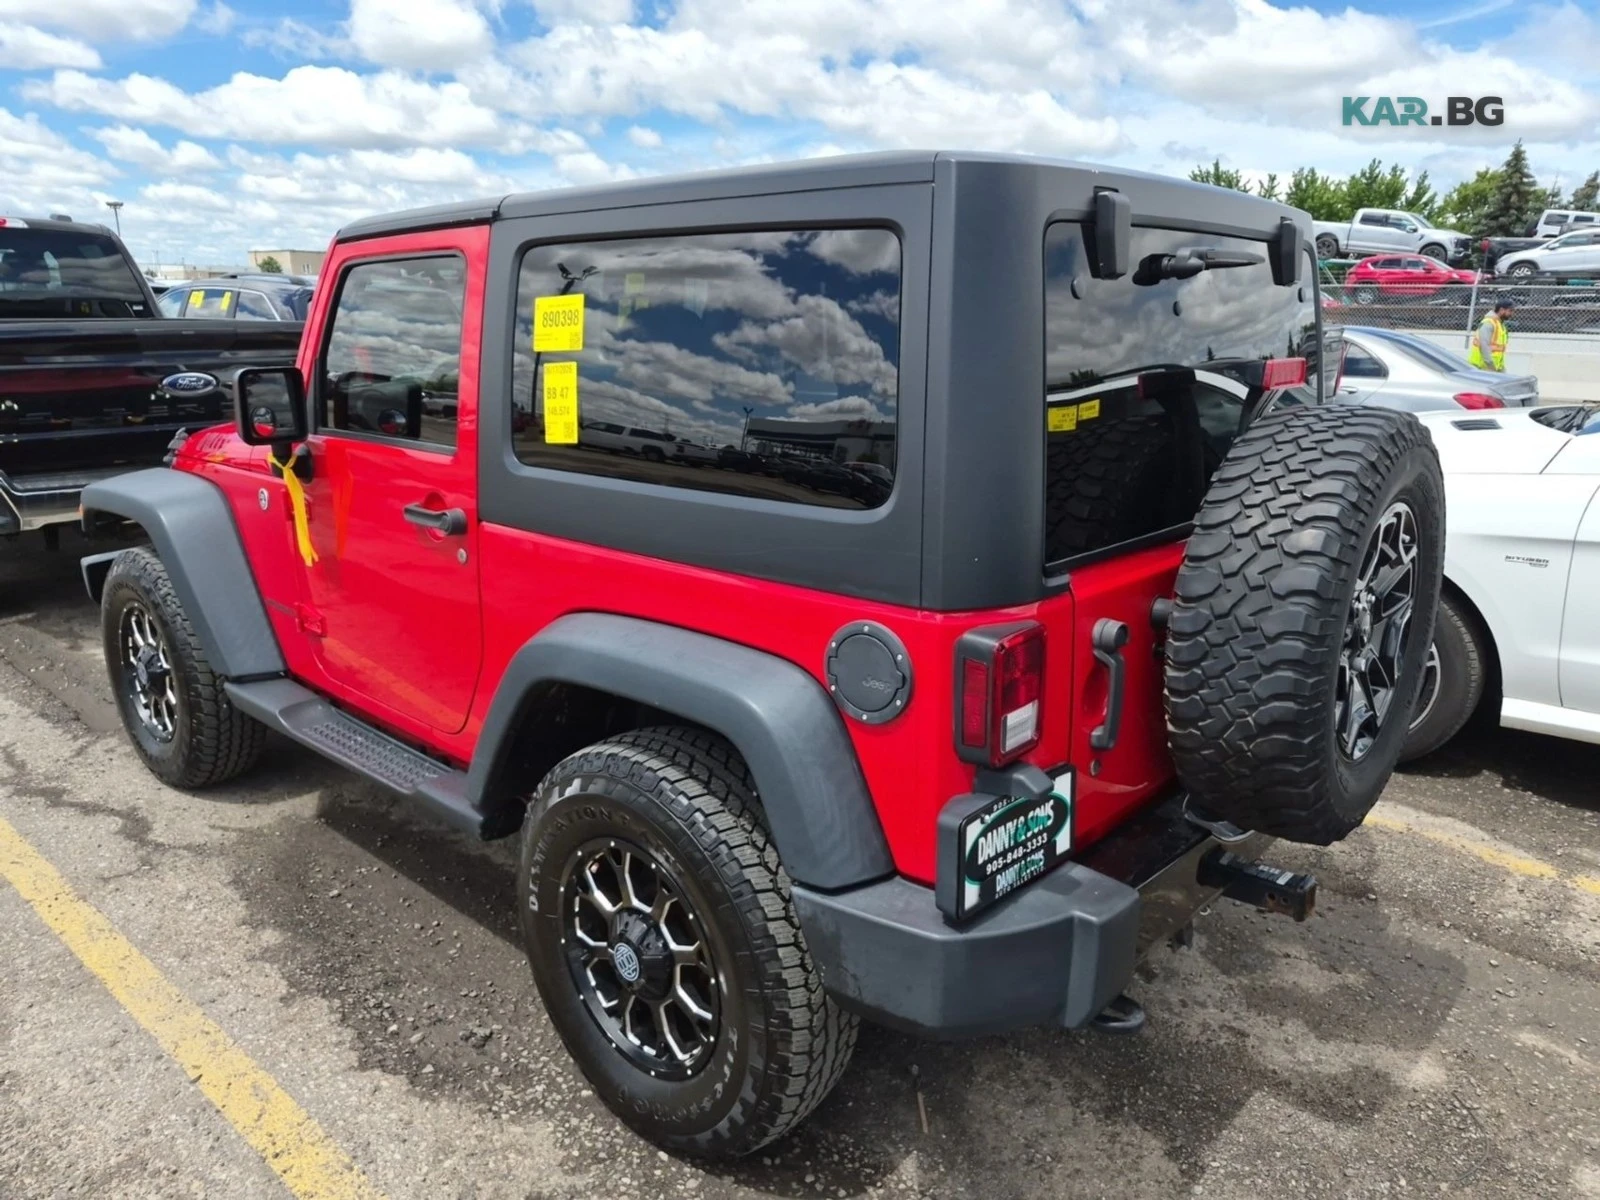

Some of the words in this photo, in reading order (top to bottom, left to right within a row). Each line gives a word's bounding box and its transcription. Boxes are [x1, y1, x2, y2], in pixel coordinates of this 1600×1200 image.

[542, 308, 580, 328] 890398
[176, 376, 205, 390] Ford
[560, 386, 569, 400] 47
[978, 818, 1017, 865] DANNY
[1026, 799, 1055, 837] SONS
[986, 832, 1048, 875] 905-848-3333
[996, 862, 1020, 892] DANNY
[1026, 849, 1045, 873] SONS
